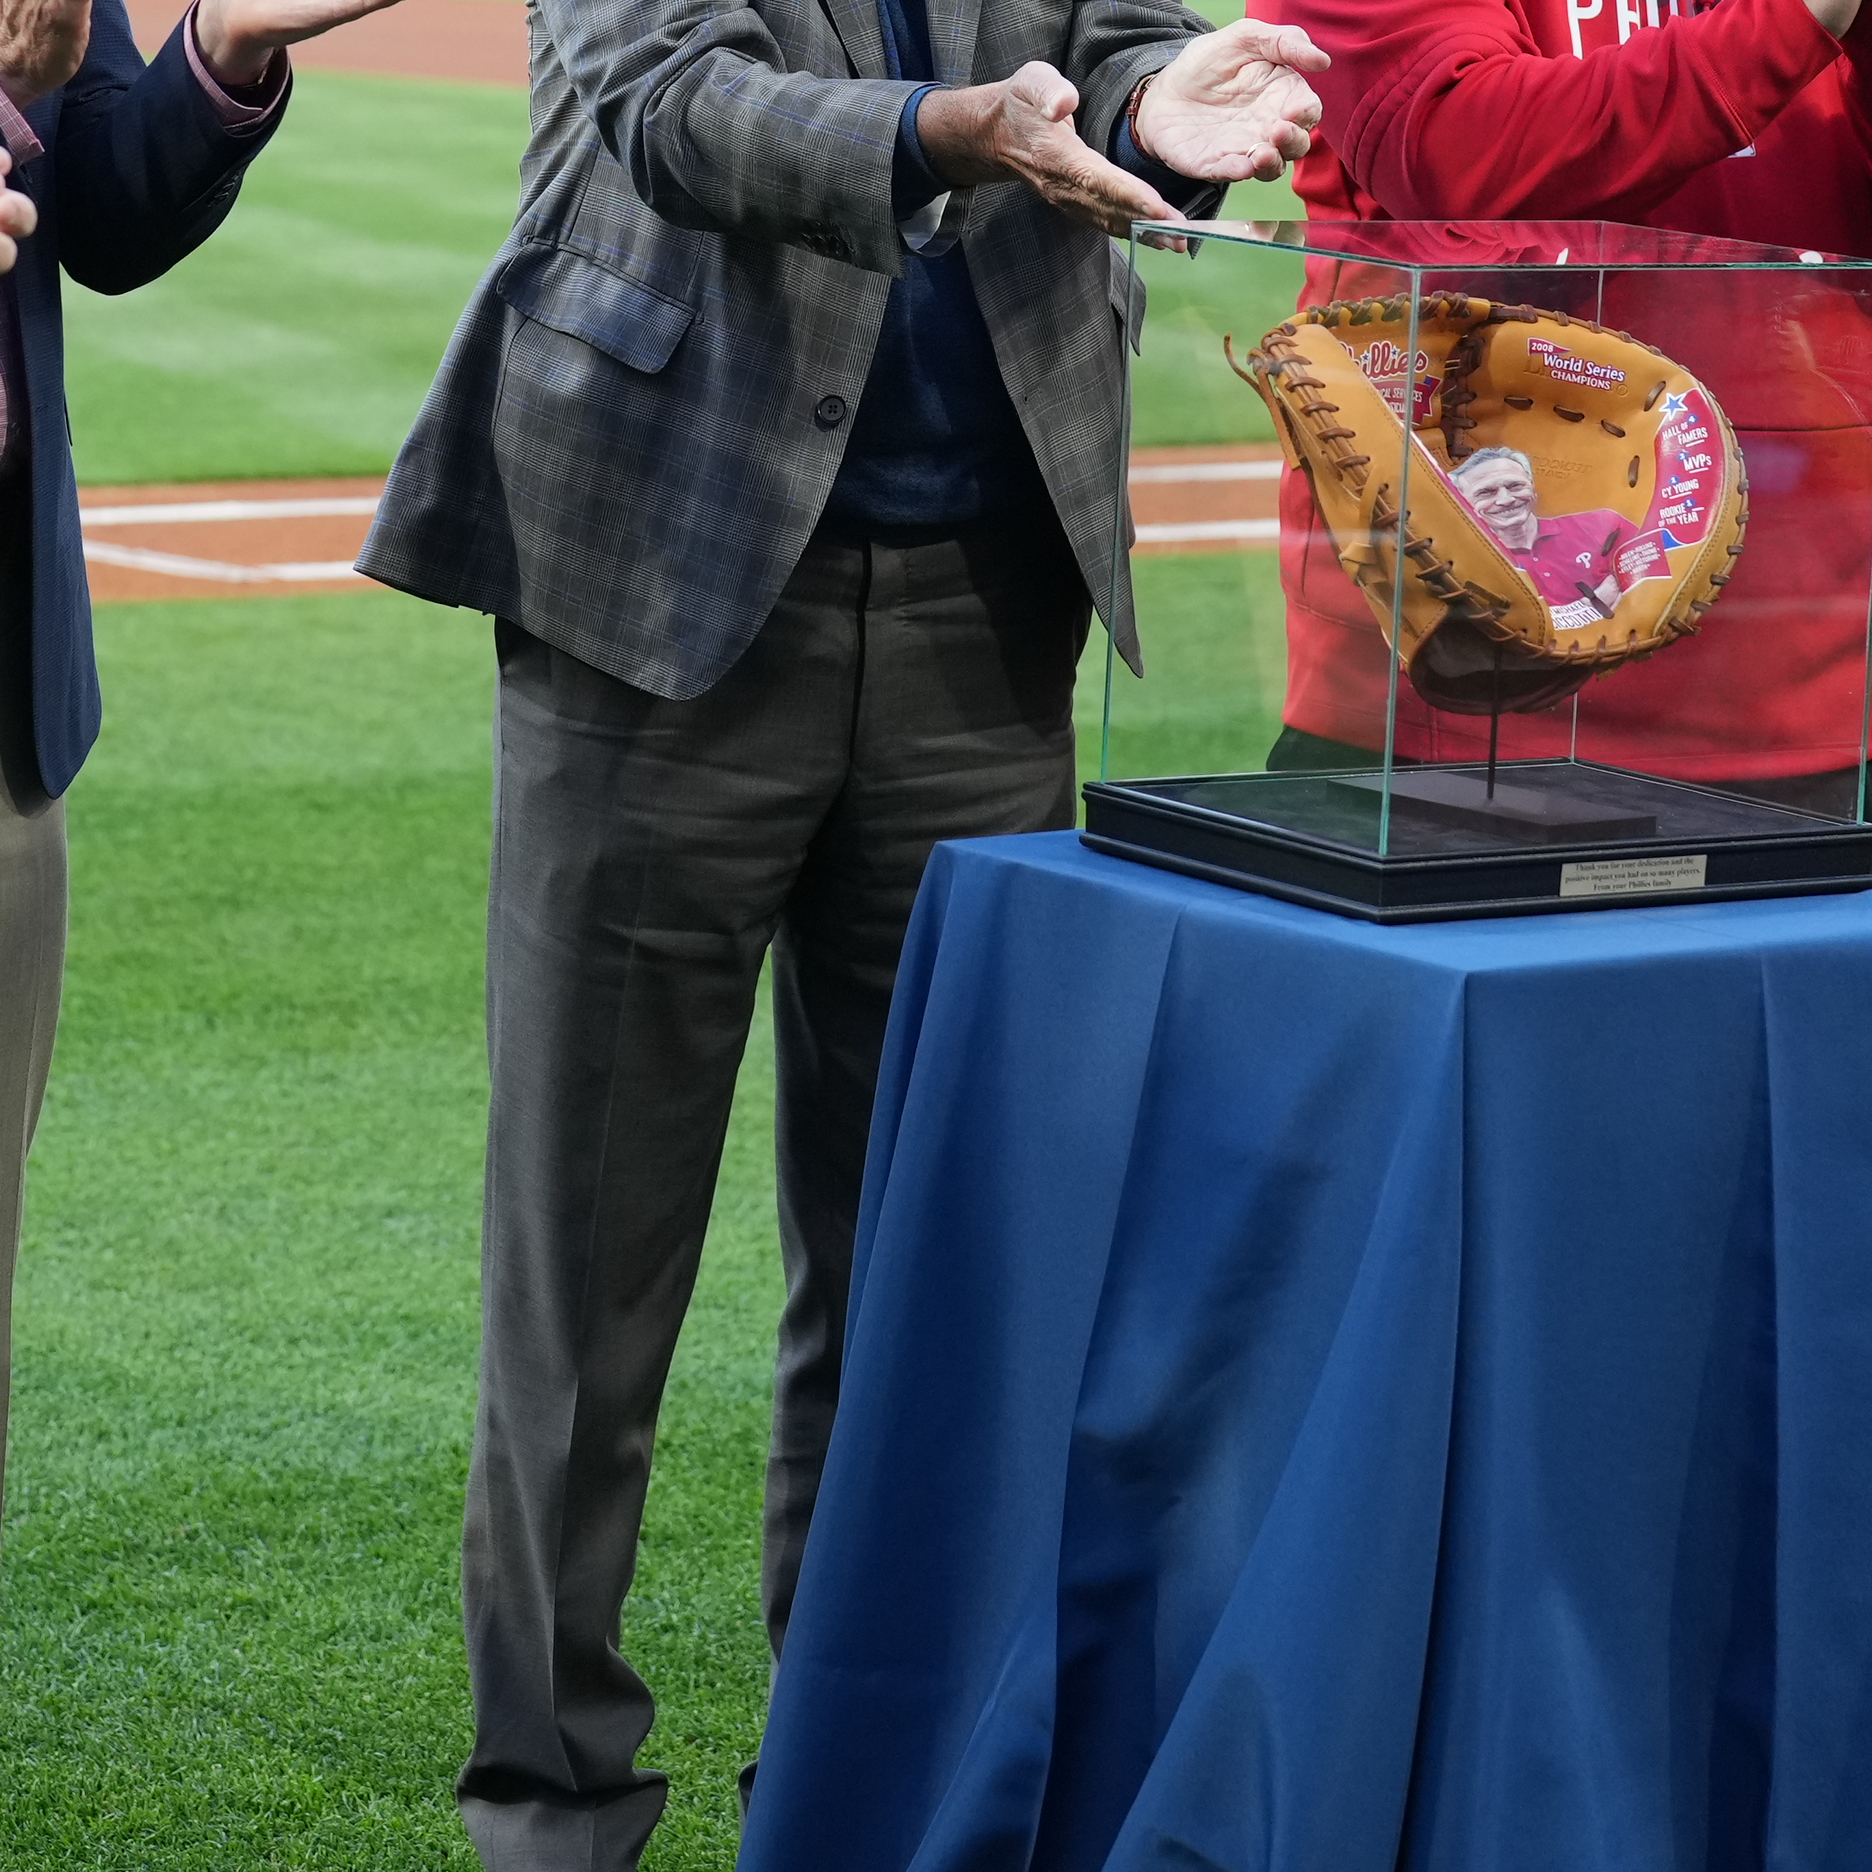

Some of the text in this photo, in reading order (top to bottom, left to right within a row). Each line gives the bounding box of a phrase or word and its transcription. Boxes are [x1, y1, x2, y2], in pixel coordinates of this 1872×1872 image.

[1531, 341, 1554, 353] 2008
[1543, 353, 1583, 373] World
[1585, 361, 1626, 382] Series
[1550, 369, 1611, 390] CHAMPIONS
[1689, 415, 1697, 424] 4
[1661, 421, 1688, 441] HALL OF
[1677, 426, 1708, 445] FAMERS
[1683, 453, 1713, 471] MVPs
[1661, 478, 1700, 499] CY YOUNG
[1659, 501, 1687, 519] ROOKIE
[1666, 516, 1677, 526] THE
[1677, 510, 1700, 525] YEAR
[1549, 600, 1587, 615] MICHAEL
[1552, 607, 1605, 630] ICCOTTI
[1576, 863, 1595, 871] Thank
[1637, 859, 1670, 867] dedication
[1565, 875, 1590, 884] positive
[1591, 873, 1613, 882] impact
[1593, 883, 1611, 891] From
[1628, 880, 1651, 888] Phillies
[1652, 878, 1671, 887] family
